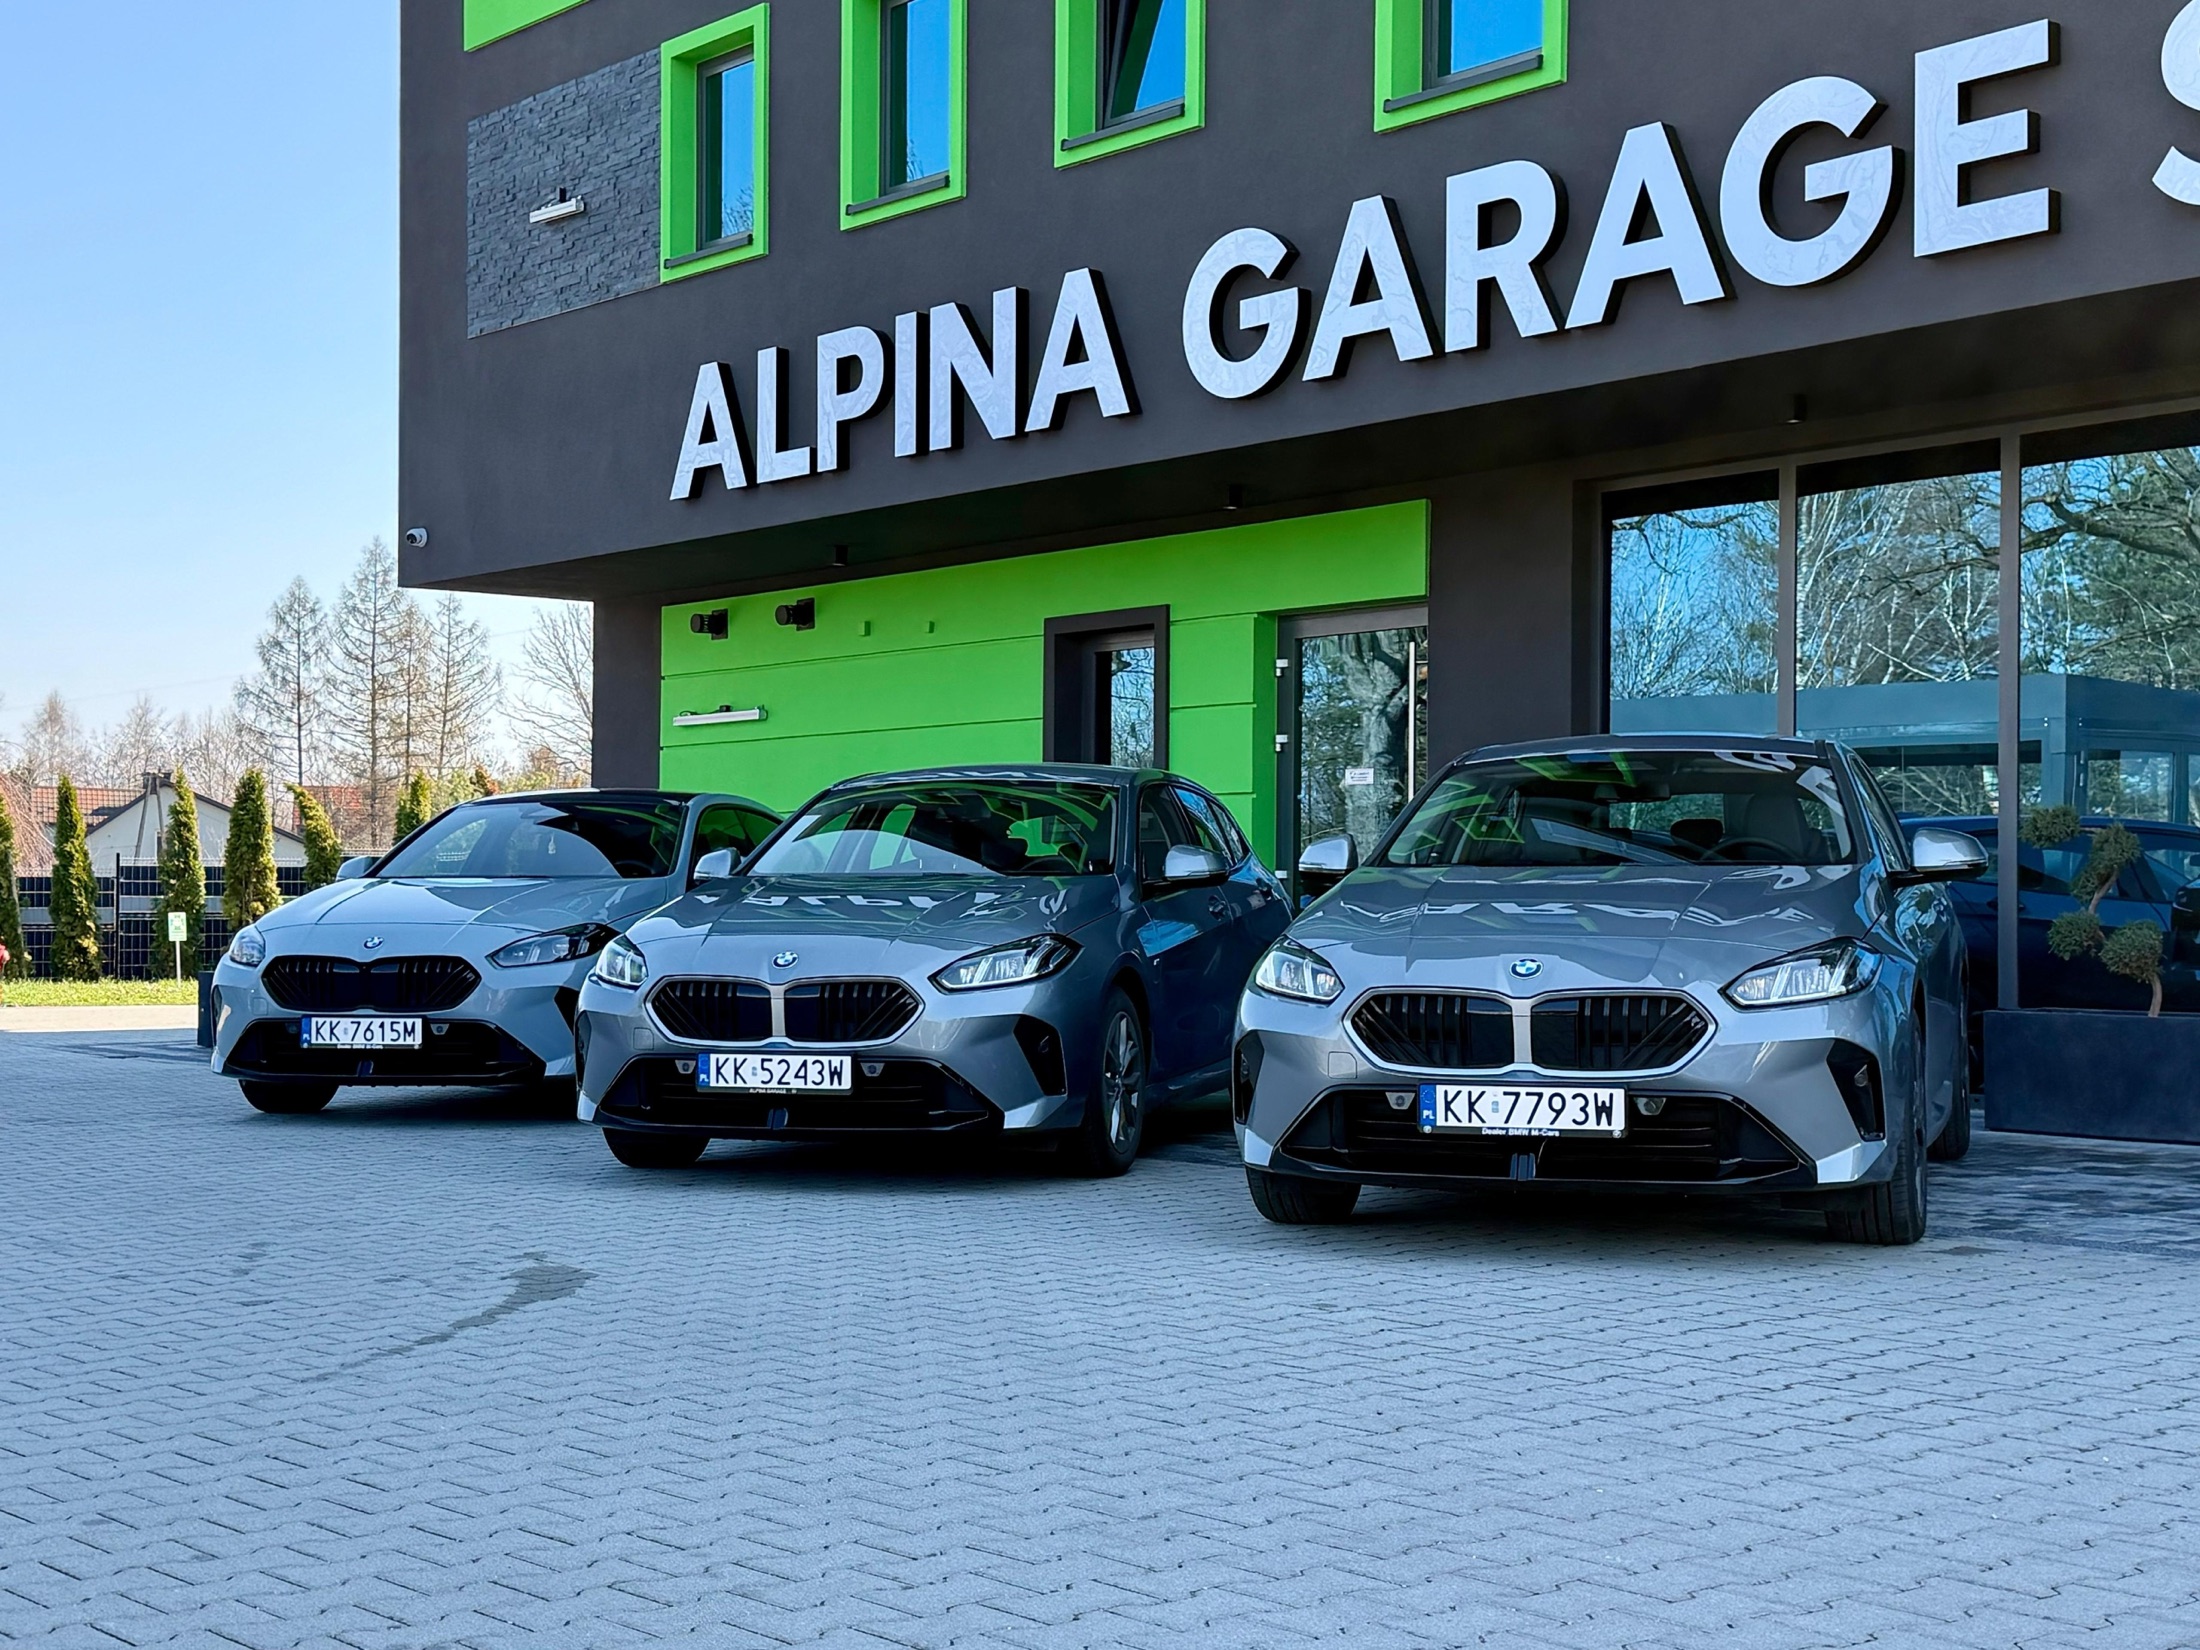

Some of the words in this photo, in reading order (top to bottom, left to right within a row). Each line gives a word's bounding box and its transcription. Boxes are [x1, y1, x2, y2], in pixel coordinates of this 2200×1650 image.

[670, 267, 1131, 500] ALPINA
[1182, 18, 2051, 400] GARAGE
[315, 1020, 341, 1042] KK
[350, 1020, 416, 1043] 7615M
[700, 1074, 709, 1082] PL
[716, 1057, 748, 1085] KK
[760, 1058, 844, 1087] 5243W
[1423, 1110, 1435, 1120] PL
[1444, 1089, 1487, 1124] KK
[1502, 1091, 1614, 1127] 7793W
[1508, 1128, 1530, 1137] BMW
